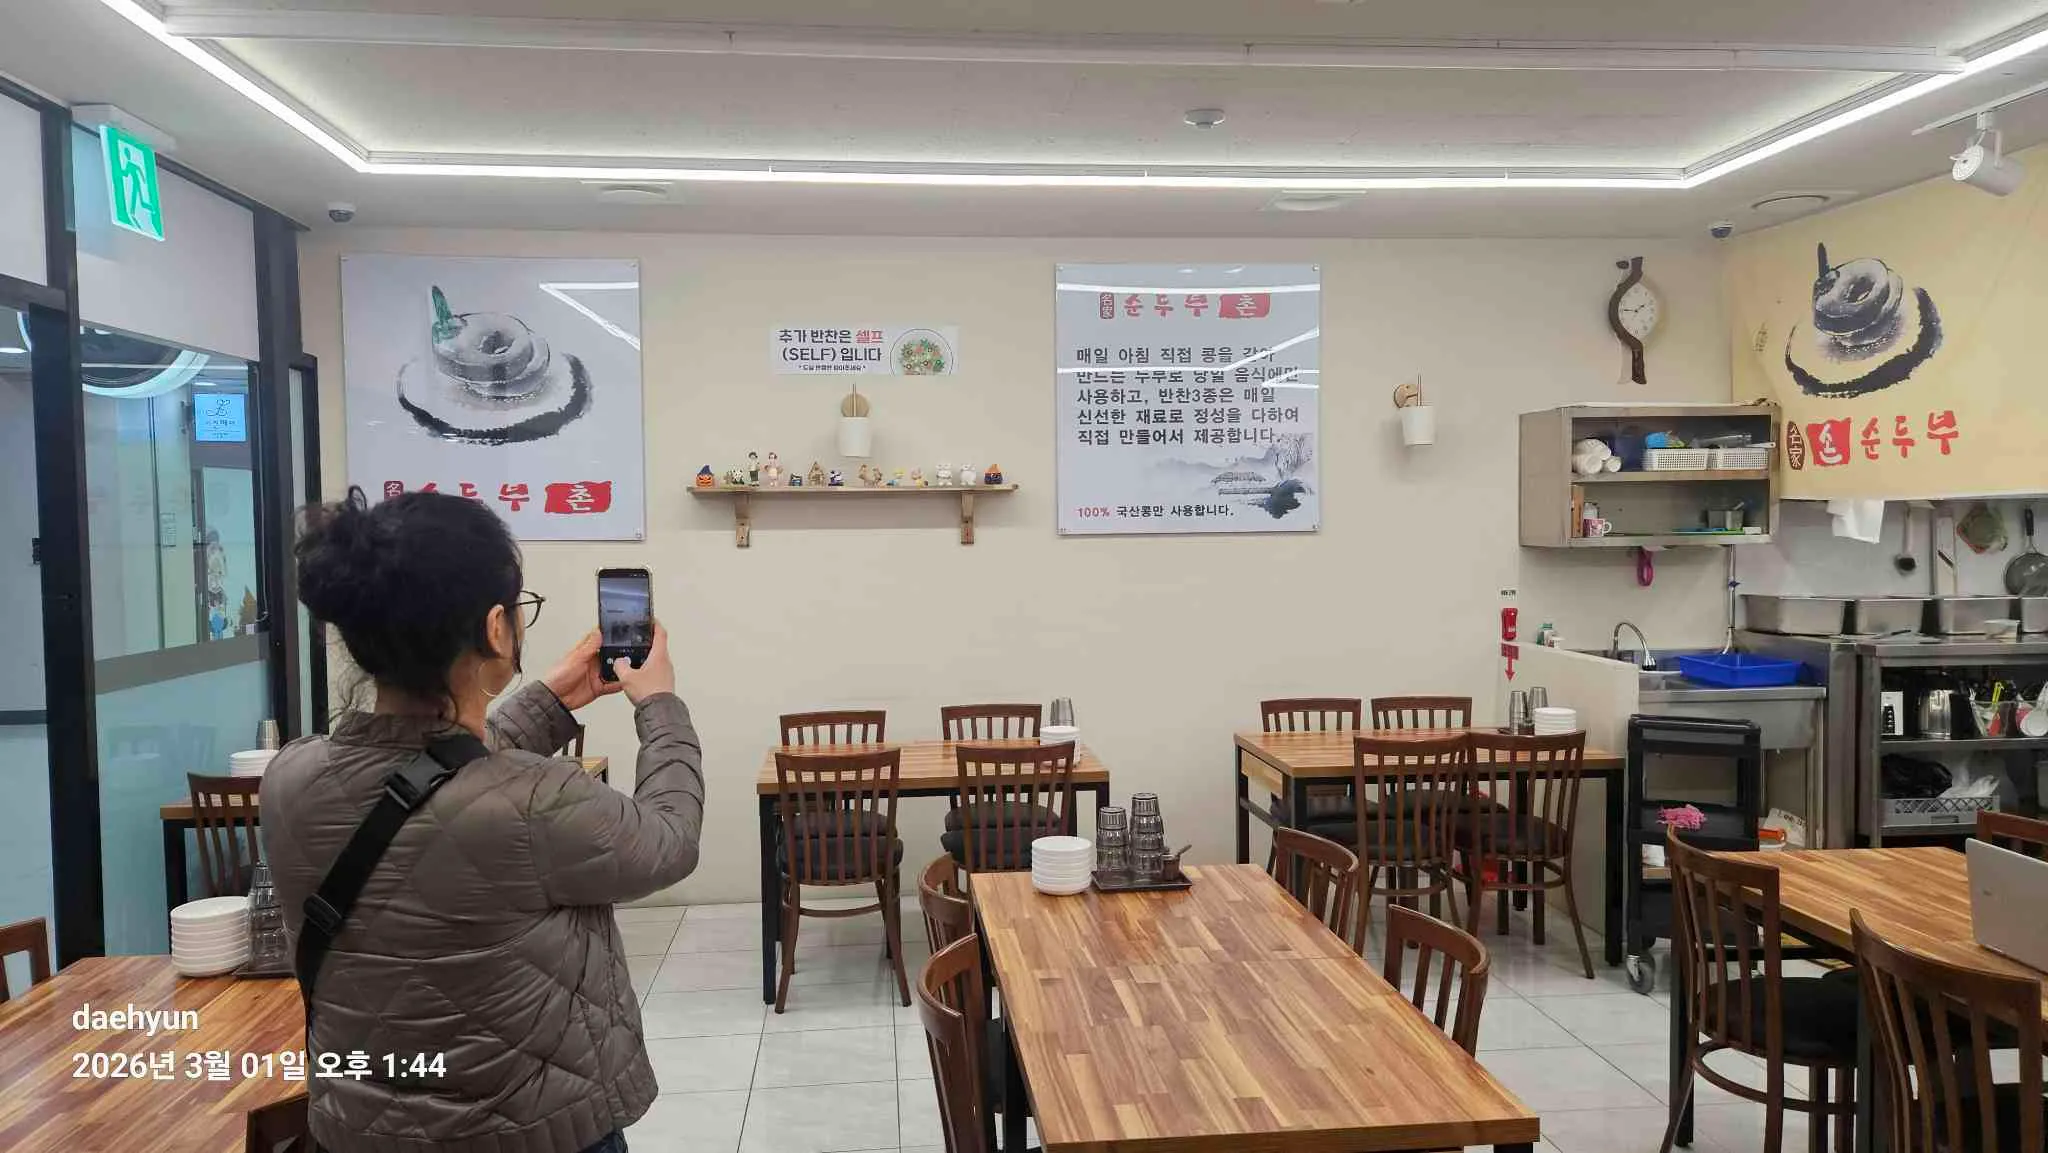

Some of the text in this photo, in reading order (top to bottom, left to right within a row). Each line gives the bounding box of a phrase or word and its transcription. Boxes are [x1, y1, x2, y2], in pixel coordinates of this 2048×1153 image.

[778, 329, 883, 344] 추가 반찬은 셀프
[782, 347, 882, 361] (SELF) 입니다
[1077, 347, 1109, 364] 매일
[1119, 347, 1149, 364] 아침
[1160, 347, 1191, 364] 직접
[1201, 347, 1233, 363] 콩을
[1077, 387, 1275, 405] 사용하고, 반찬3종은 매일
[1077, 407, 1299, 425] 신선한 재료로 정성을 다하여
[1078, 428, 1281, 446] 직접 만들어서 제공합니다.
[1860, 410, 1960, 461] 순두부
[1078, 504, 1234, 518] 100% 국산콩만 사용합니다.
